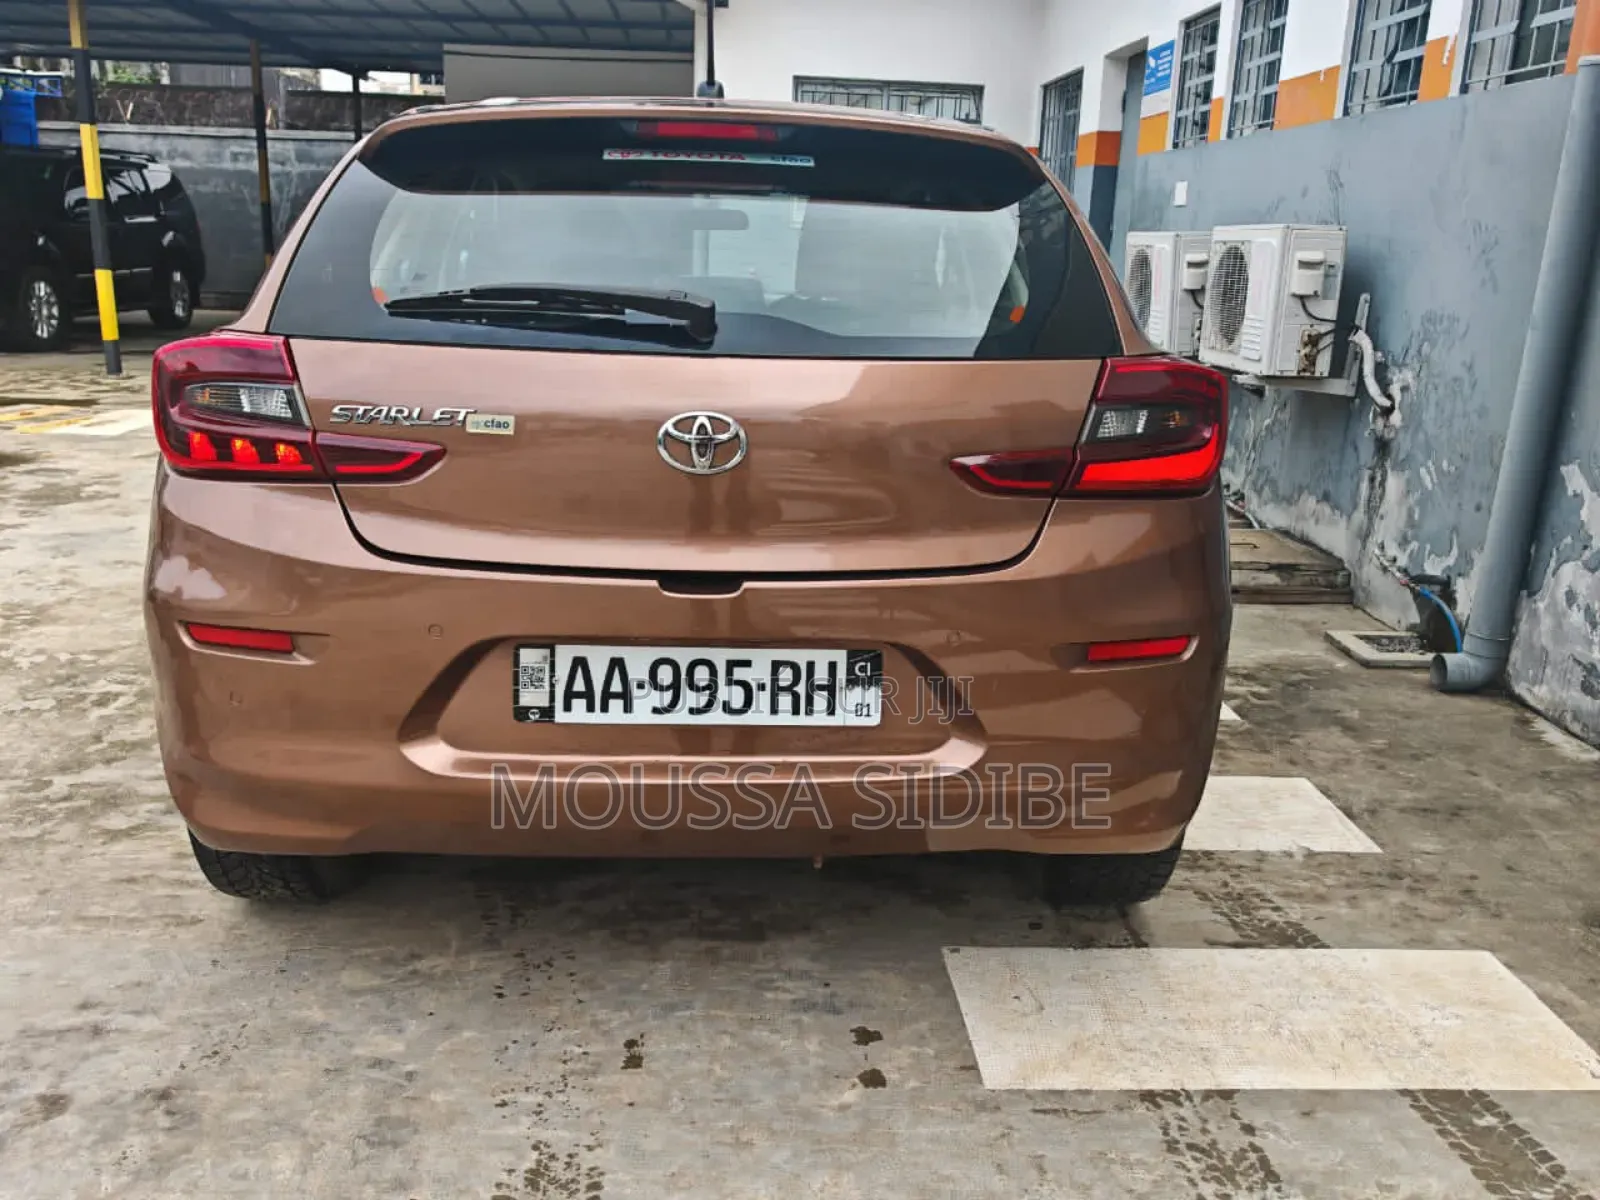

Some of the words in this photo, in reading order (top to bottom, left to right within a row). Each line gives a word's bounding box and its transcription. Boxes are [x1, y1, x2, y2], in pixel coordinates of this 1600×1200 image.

[651, 150, 746, 161] TOYOTA
[329, 404, 477, 428] STARLET
[483, 418, 510, 430] cfao
[854, 661, 871, 676] CI
[854, 703, 872, 717] 01
